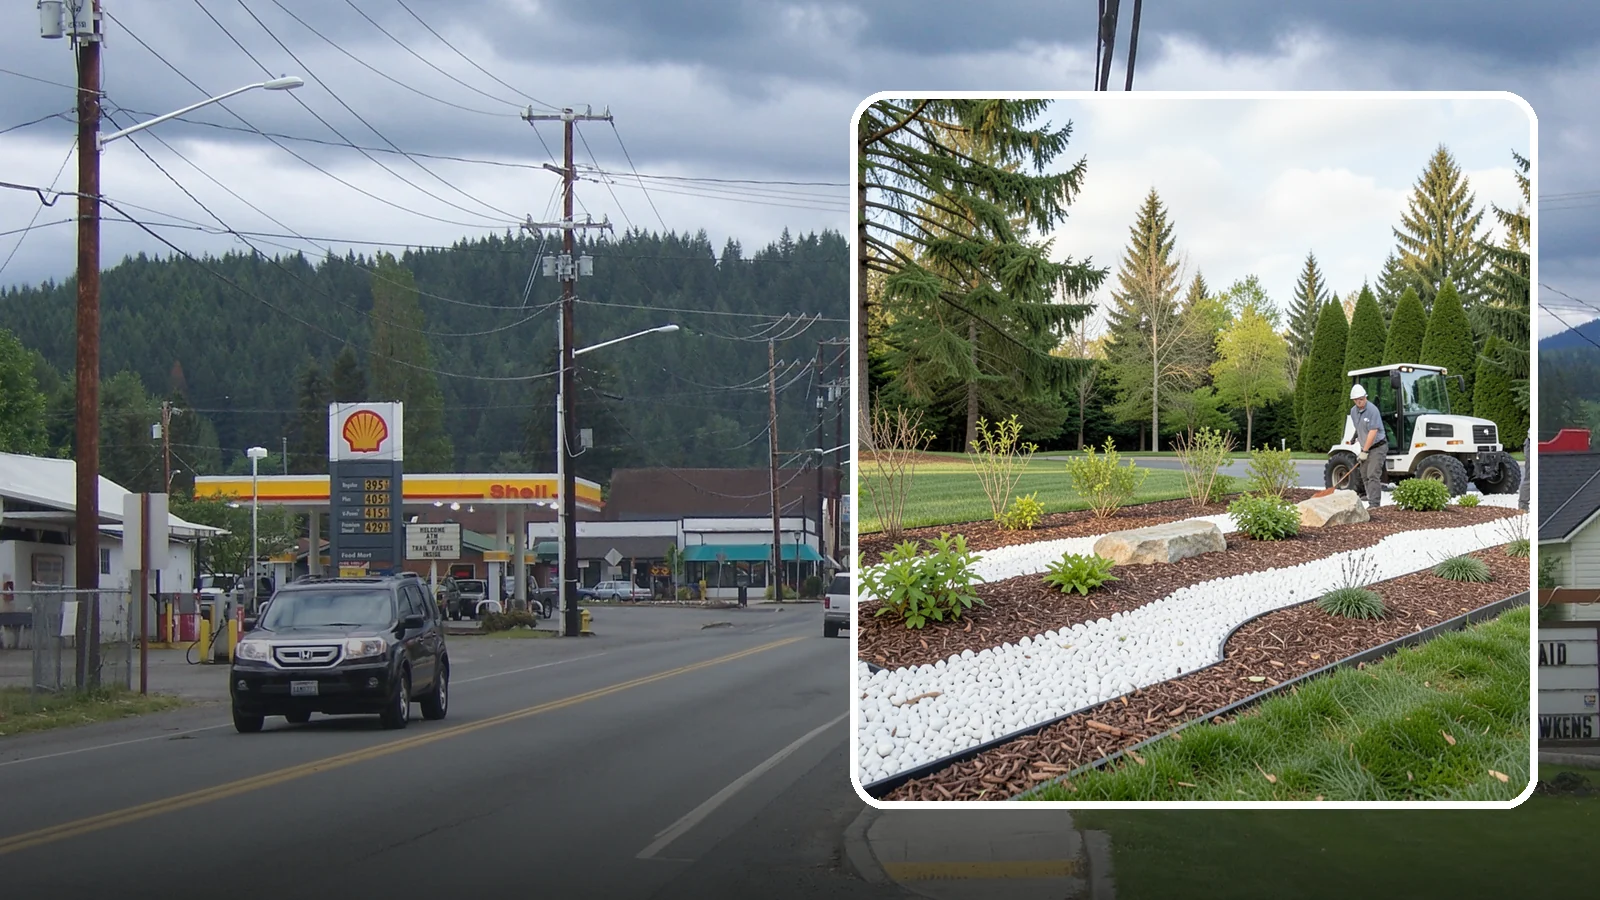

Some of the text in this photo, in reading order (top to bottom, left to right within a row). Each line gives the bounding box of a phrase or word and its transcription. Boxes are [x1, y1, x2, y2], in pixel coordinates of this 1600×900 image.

[366, 480, 383, 490] 395
[490, 484, 546, 498] Shell
[366, 494, 383, 504] 405
[366, 508, 383, 518] 415
[366, 522, 383, 533] 429
